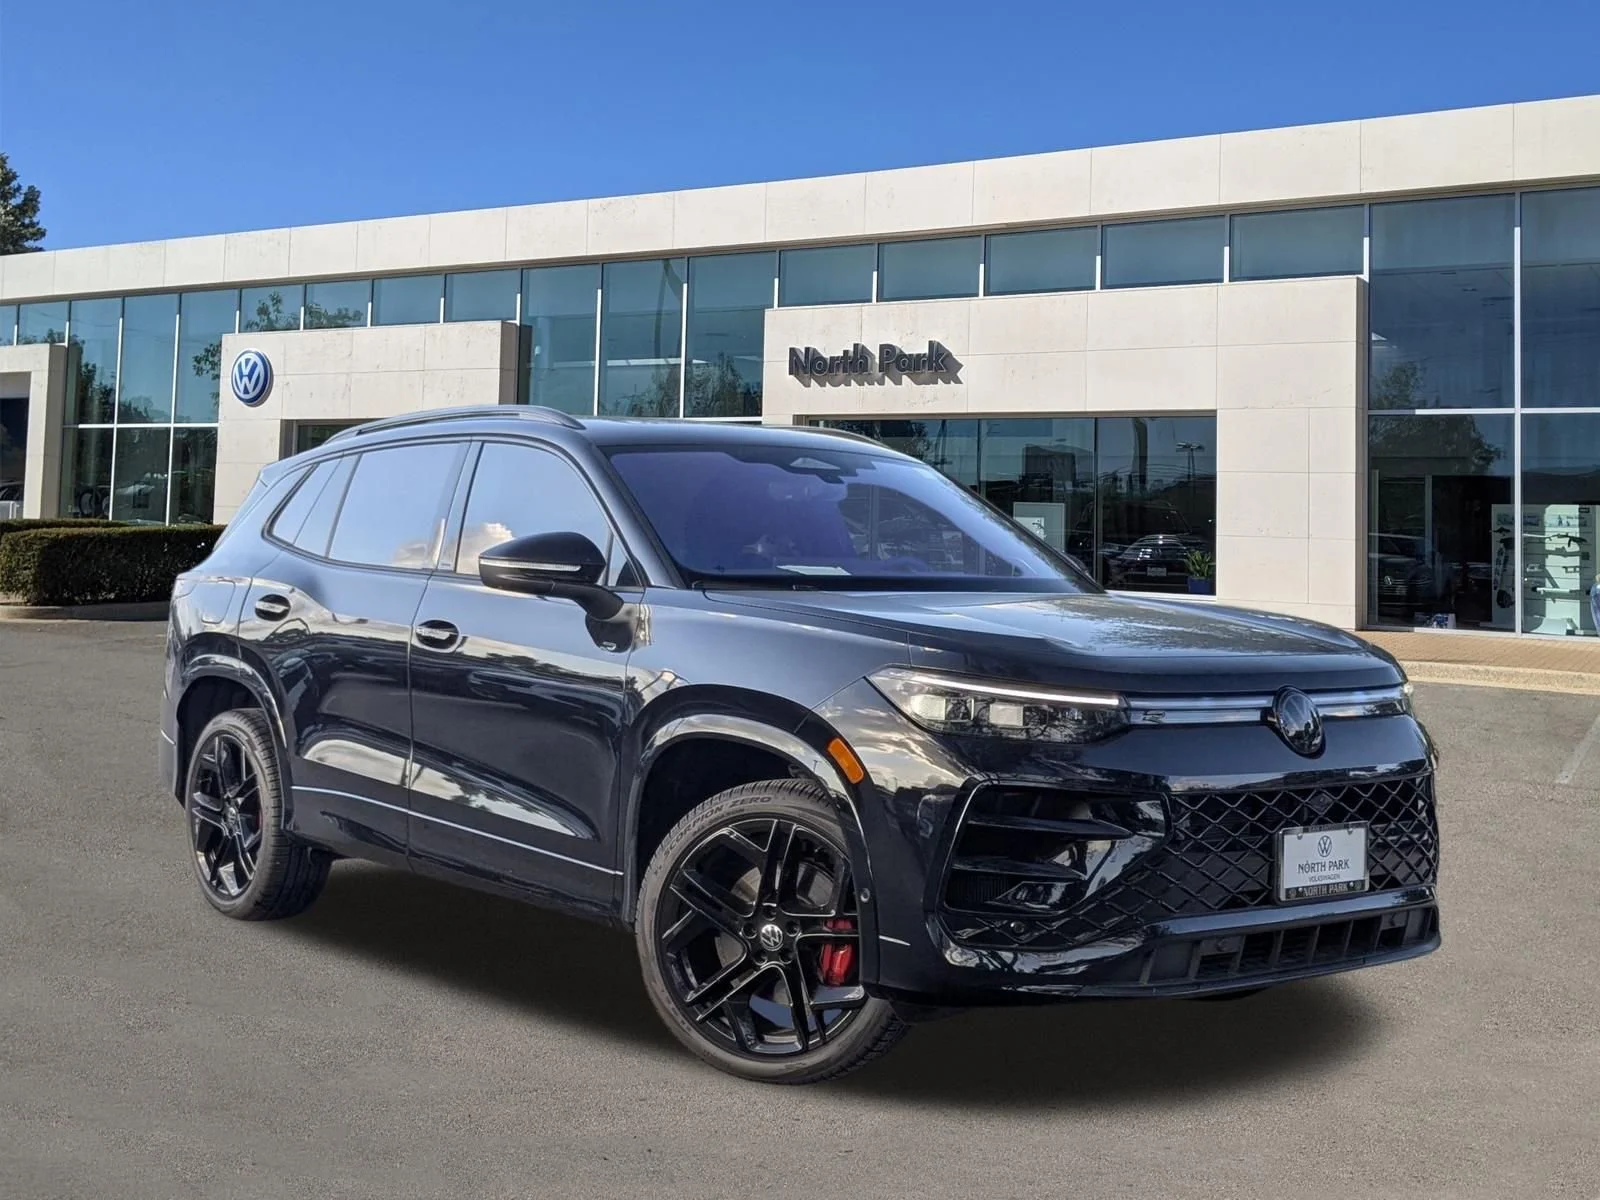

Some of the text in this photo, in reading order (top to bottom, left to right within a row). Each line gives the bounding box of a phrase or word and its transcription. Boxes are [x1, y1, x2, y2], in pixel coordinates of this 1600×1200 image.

[789, 340, 947, 375] North Park
[663, 804, 724, 857] SCORPION
[729, 796, 772, 808] ZERO
[1298, 859, 1350, 873] NORTH PARK
[1303, 882, 1348, 897] NORTH PARK
